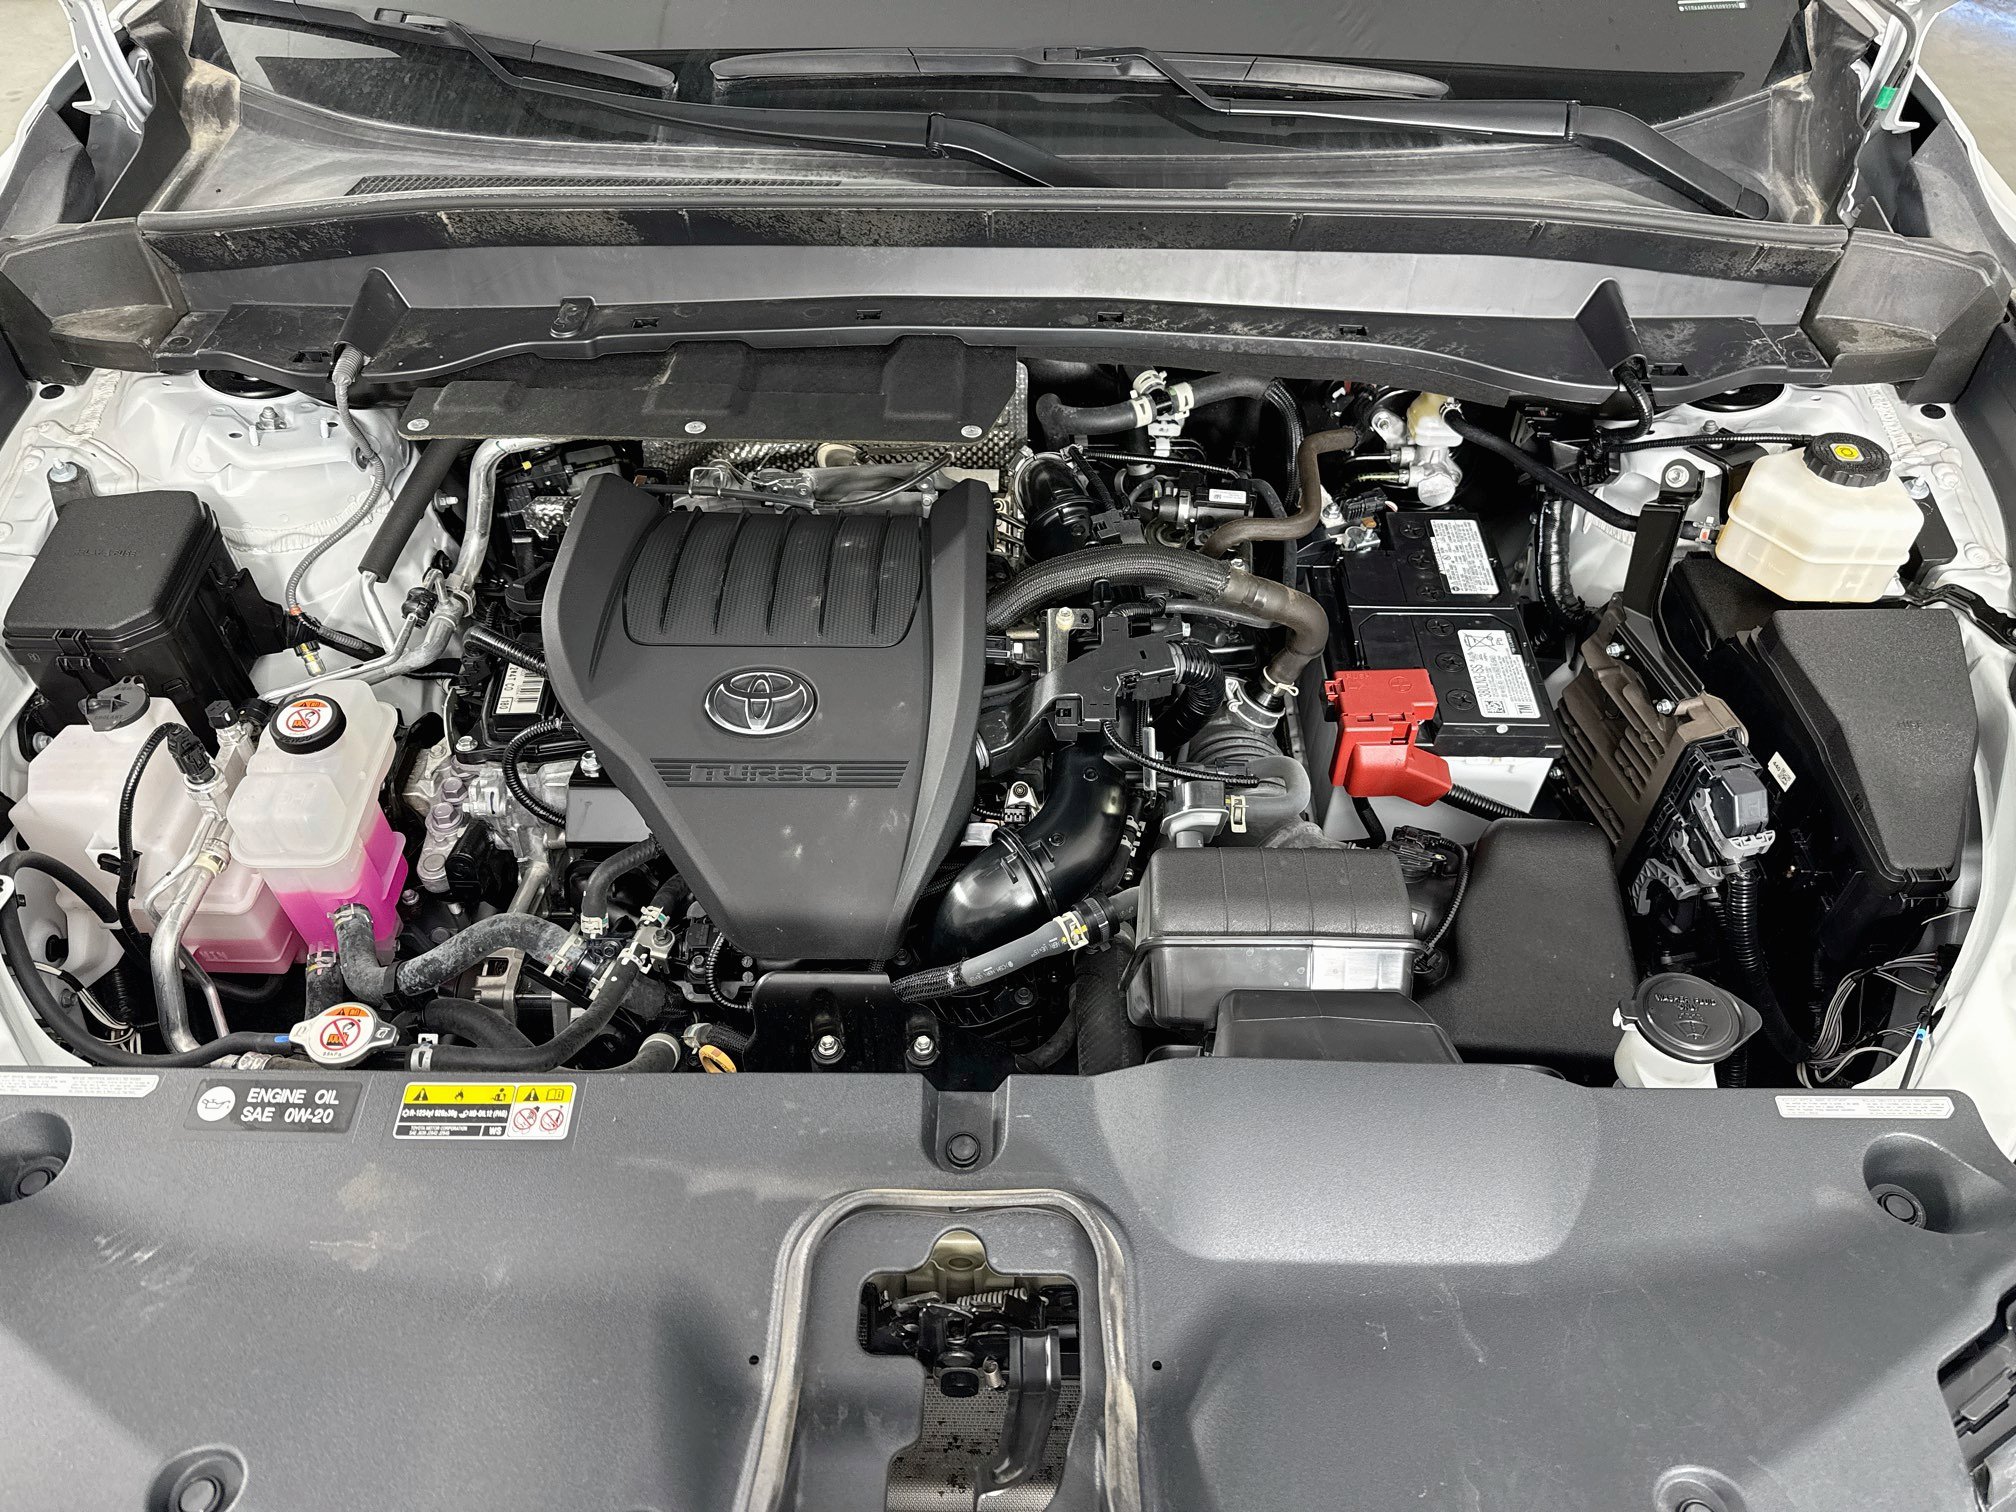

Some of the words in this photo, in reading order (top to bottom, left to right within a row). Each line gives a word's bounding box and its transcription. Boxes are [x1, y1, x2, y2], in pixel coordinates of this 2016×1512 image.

[695, 764, 832, 782] TURBO
[246, 1088, 307, 1104] ENGINE
[314, 1089, 339, 1105] OIL
[240, 1106, 276, 1122] SAE
[284, 1107, 334, 1124] 0W-20
[488, 1127, 502, 1136] WS
